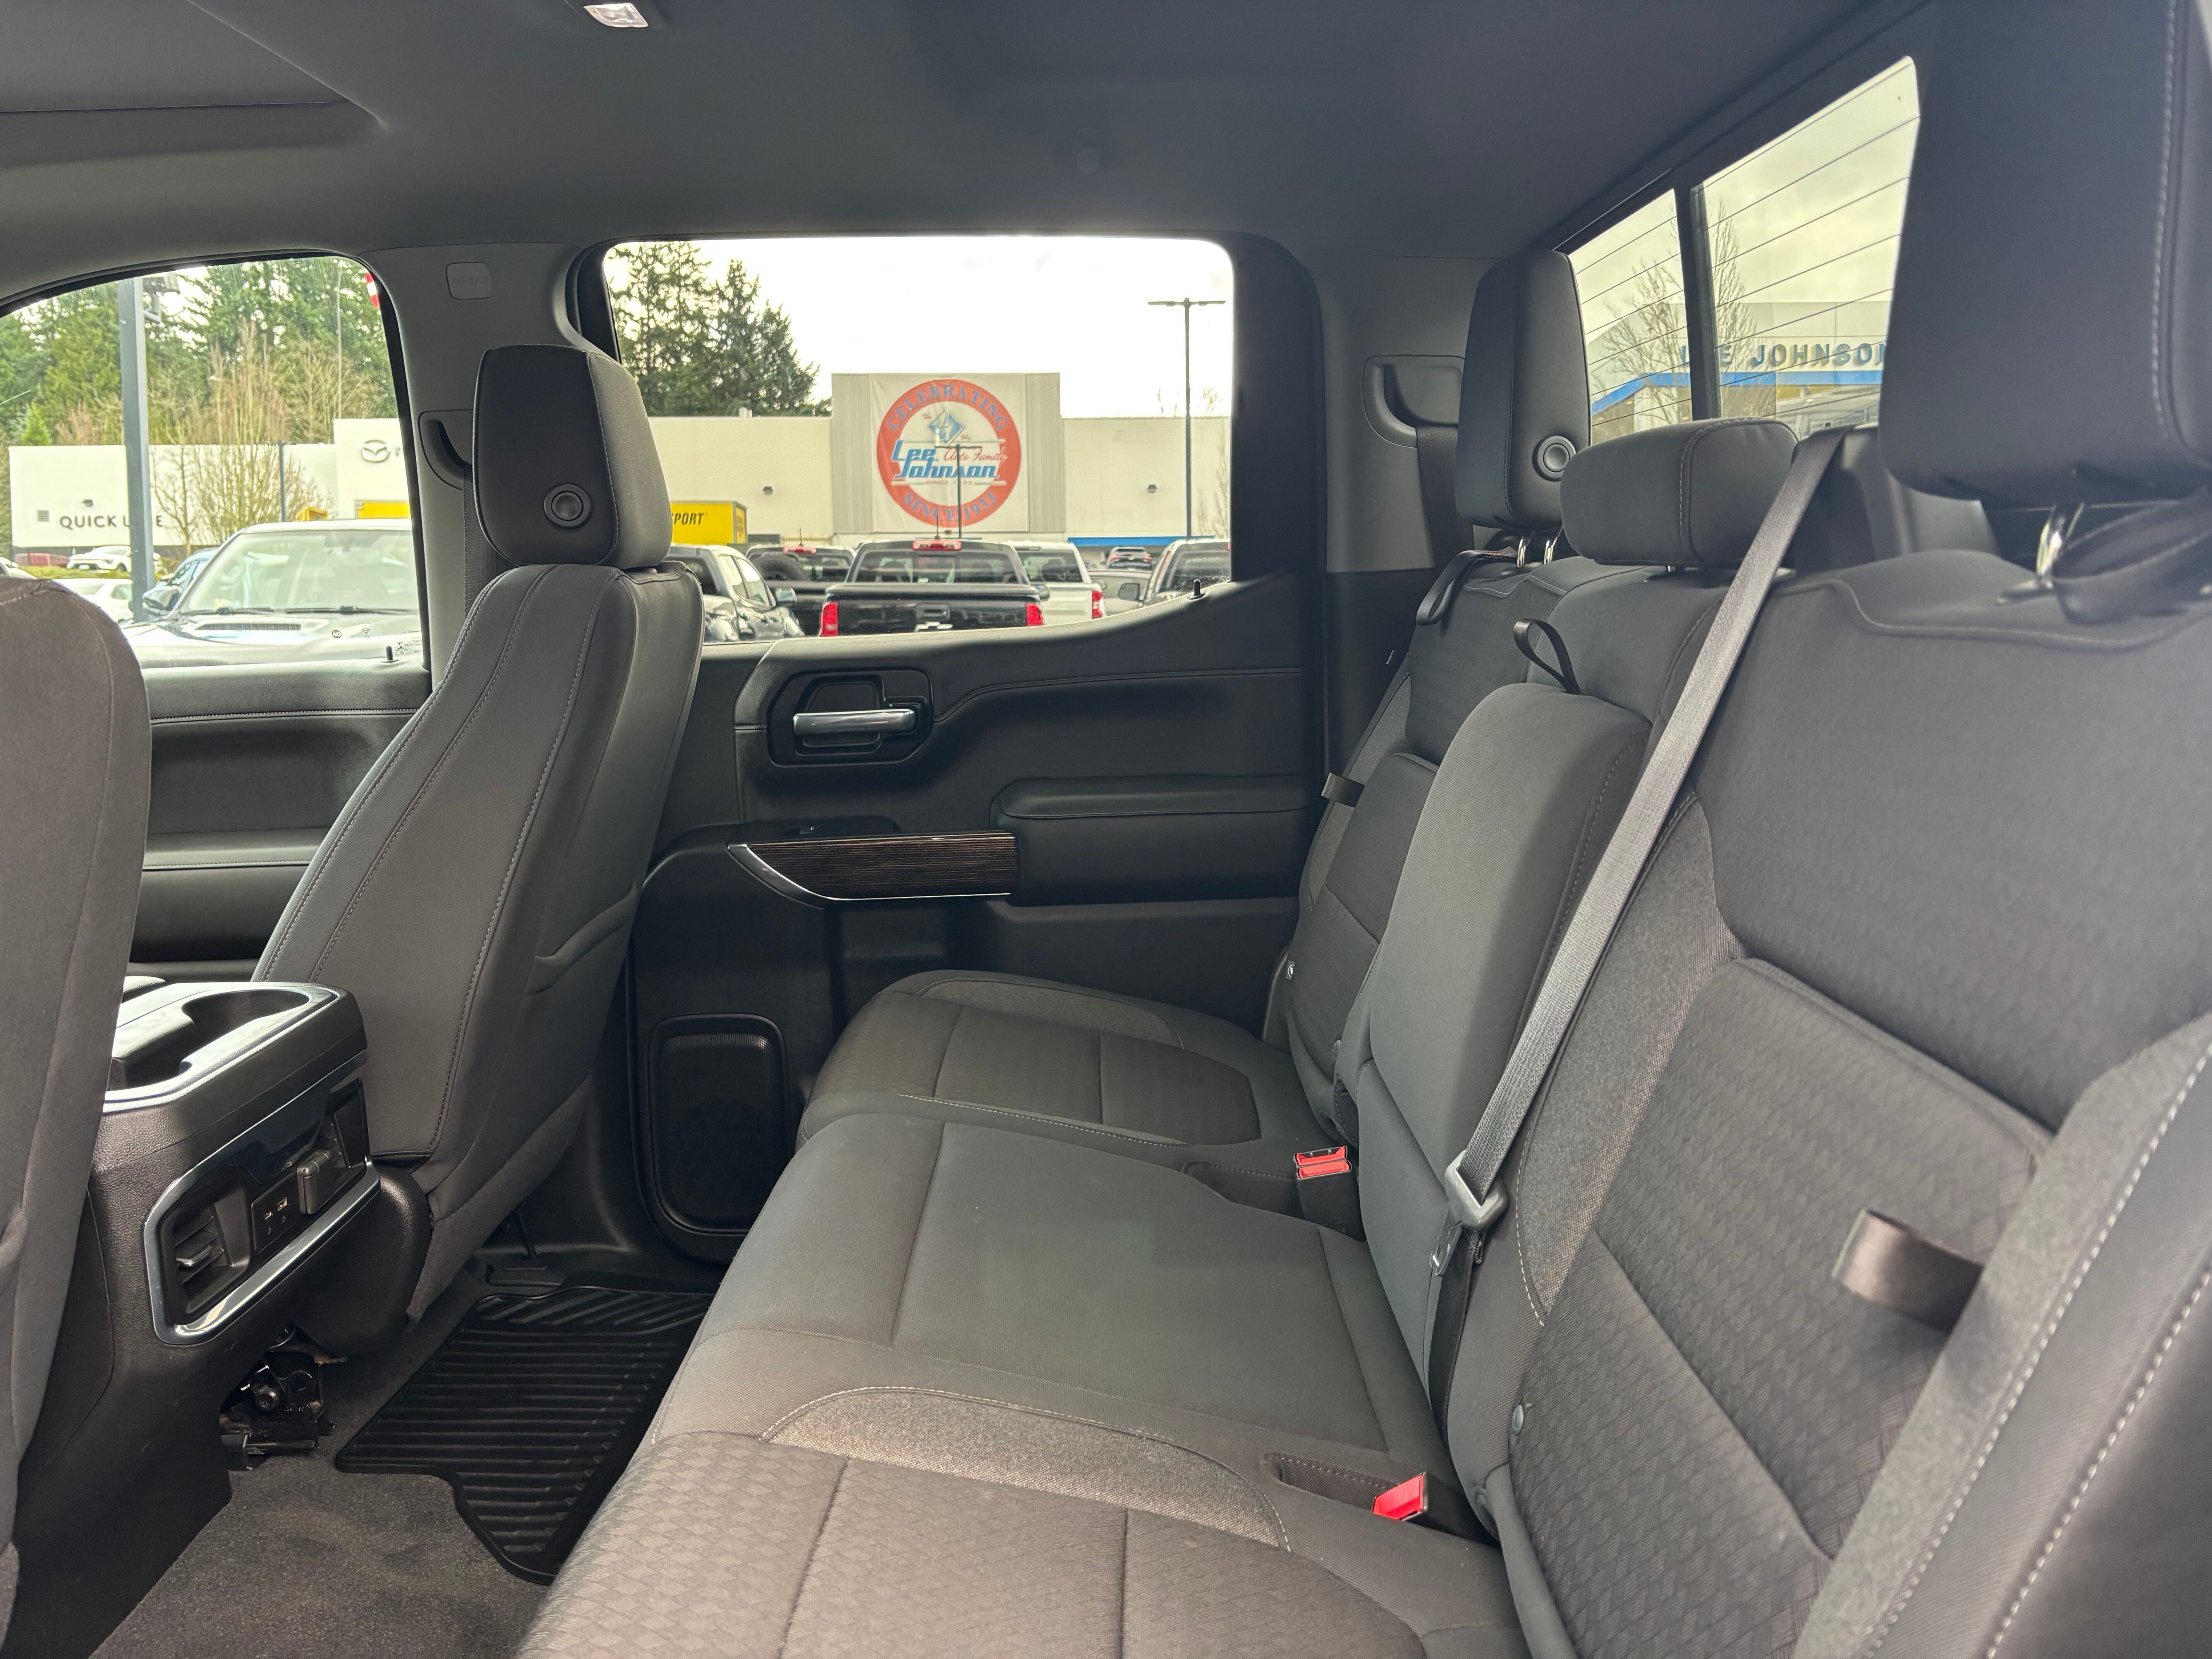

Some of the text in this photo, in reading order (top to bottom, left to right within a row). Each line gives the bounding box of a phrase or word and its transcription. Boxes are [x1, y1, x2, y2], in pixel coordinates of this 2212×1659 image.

[1681, 345, 1731, 365] LE
[887, 384, 1009, 430] CELEBRATING
[892, 440, 939, 461] Lee
[973, 447, 1008, 467] Family
[894, 456, 1000, 478] Johnson
[902, 492, 997, 523] SINCE 1933
[60, 515, 163, 530] QUICK LE
[672, 513, 704, 526] PORT
